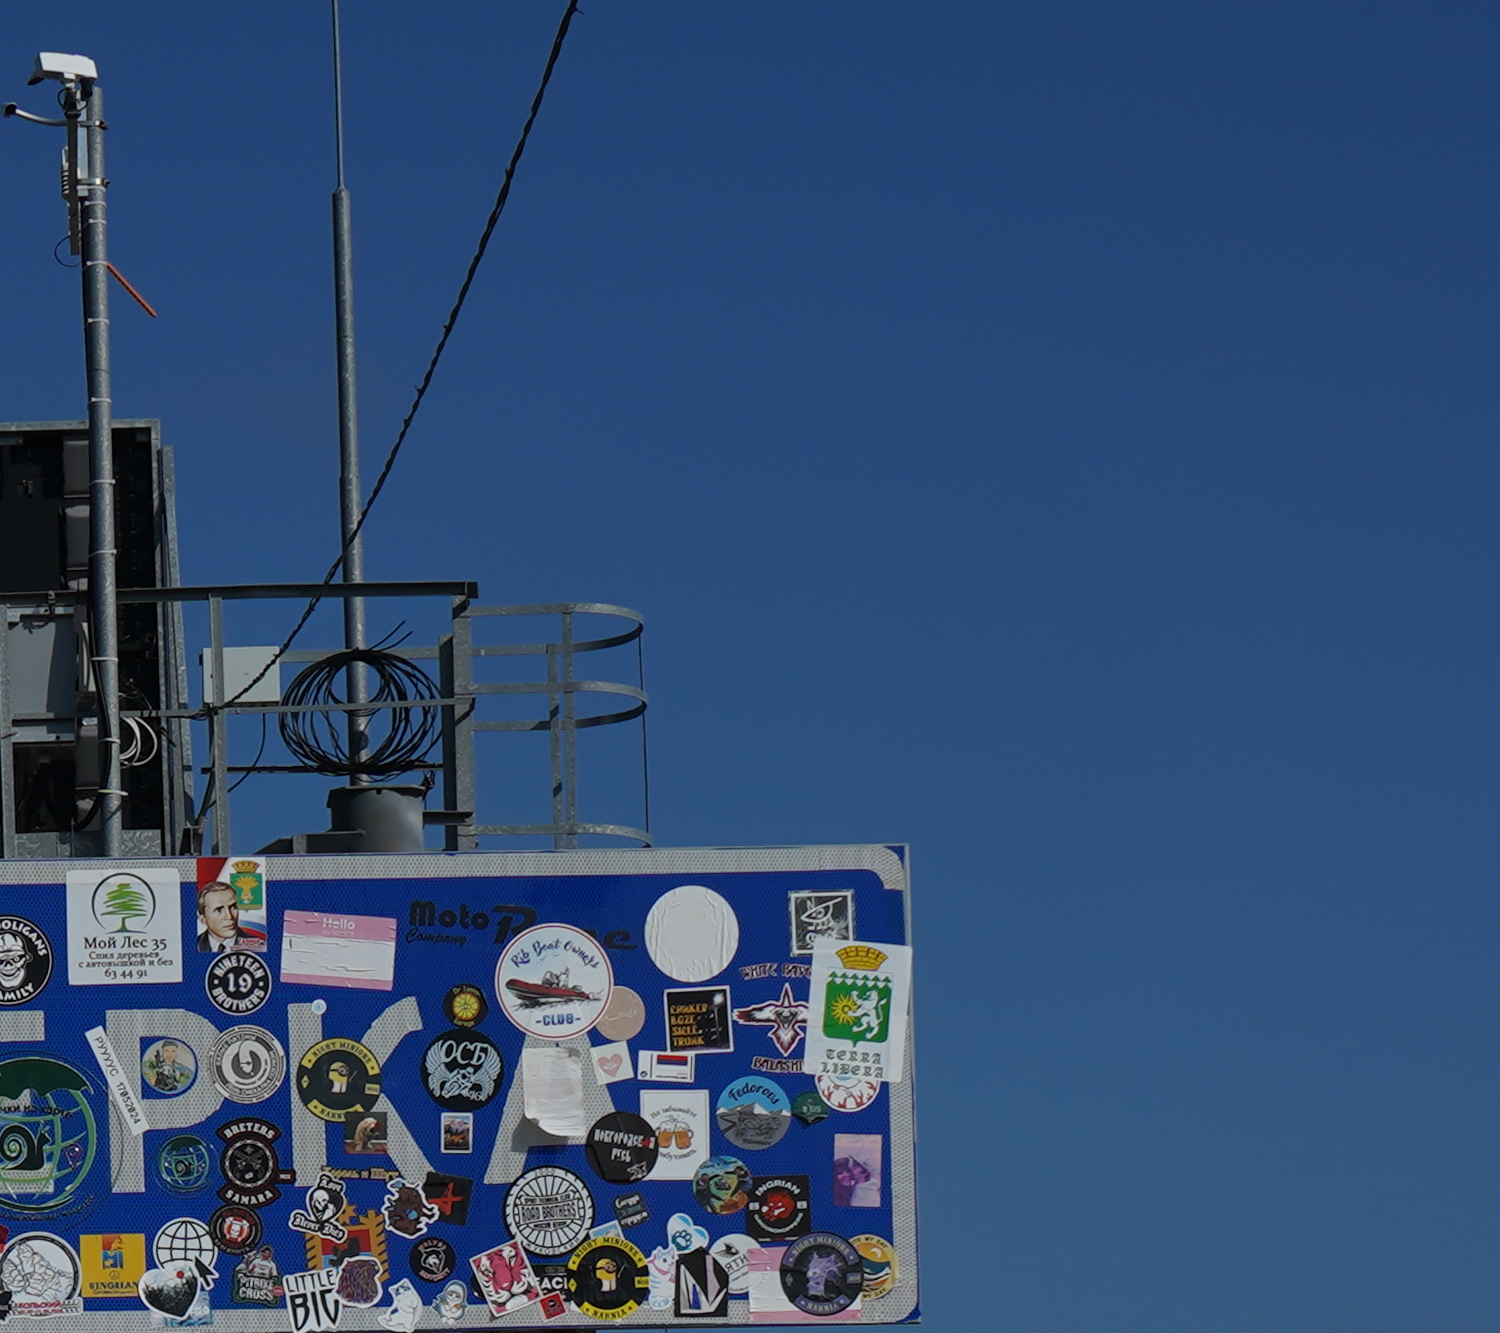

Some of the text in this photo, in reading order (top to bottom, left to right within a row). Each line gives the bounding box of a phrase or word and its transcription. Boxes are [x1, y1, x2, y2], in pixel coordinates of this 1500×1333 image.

[322, 917, 355, 930] Hello
[84, 936, 167, 951] Мой Лес 35
[214, 954, 265, 977] NINETEEN
[511, 950, 530, 968] Rib
[104, 969, 147, 979] 63 44 91
[226, 972, 253, 993] 19
[212, 988, 265, 1011] BROTHERS
[444, 1041, 487, 1065] ОСБ
[826, 1049, 882, 1065] TERRA
[820, 1062, 884, 1079] LIBERA
[117, 1082, 141, 1125] 17052024
[223, 1123, 276, 1140] BRETERS
[755, 1179, 801, 1196] INGRIAN
[224, 1190, 274, 1205] SAMARA
[542, 1202, 577, 1220] BROTHERS
[575, 1237, 641, 1260] NIGHT MINIONS
[286, 1270, 336, 1292] LITTLE
[289, 1291, 340, 1331] BIG
[592, 1309, 627, 1320] NARNIA
